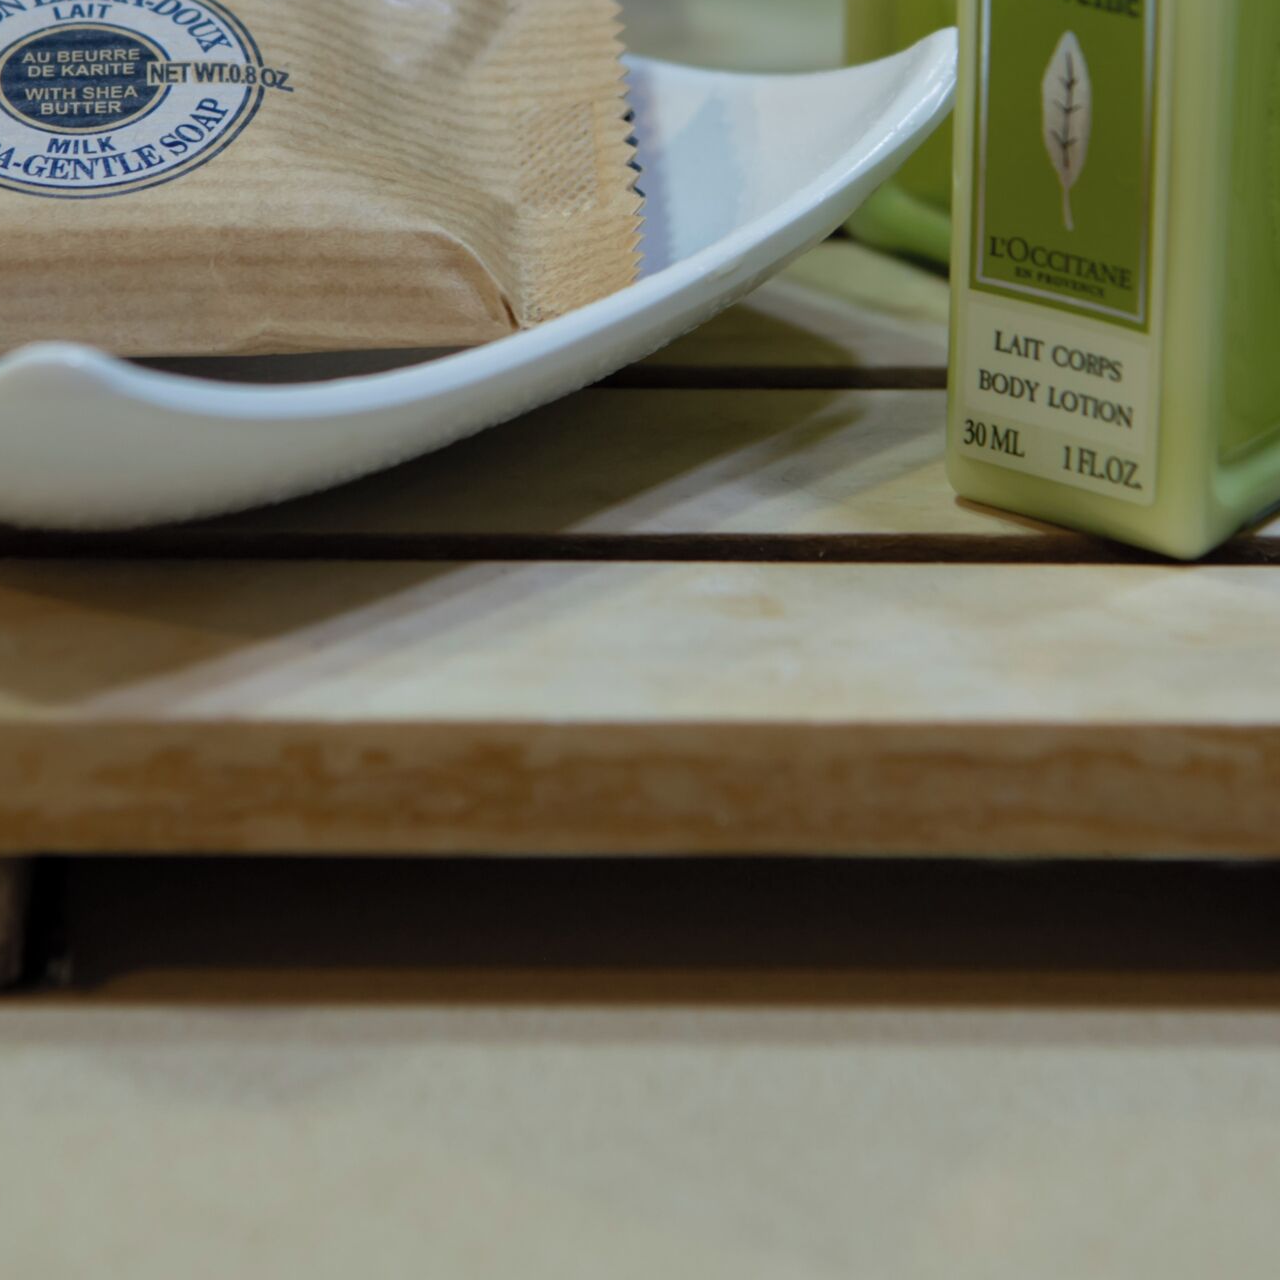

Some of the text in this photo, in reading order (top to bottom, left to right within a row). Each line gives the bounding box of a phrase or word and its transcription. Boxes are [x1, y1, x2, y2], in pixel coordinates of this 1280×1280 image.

[52, 3, 113, 21] LAIT
[22, 48, 141, 63] AU BEURRE
[27, 62, 136, 77] DE KARITE
[150, 62, 191, 83] NET
[24, 85, 138, 100] WITH SHEA
[40, 101, 122, 115] BUTTER
[161, 96, 228, 156] SOAP
[47, 136, 116, 155] MILK
[994, 329, 1123, 383] LAIT CORPS
[978, 369, 1133, 429] BODY LOTION
[963, 419, 1025, 458] 30 ML
